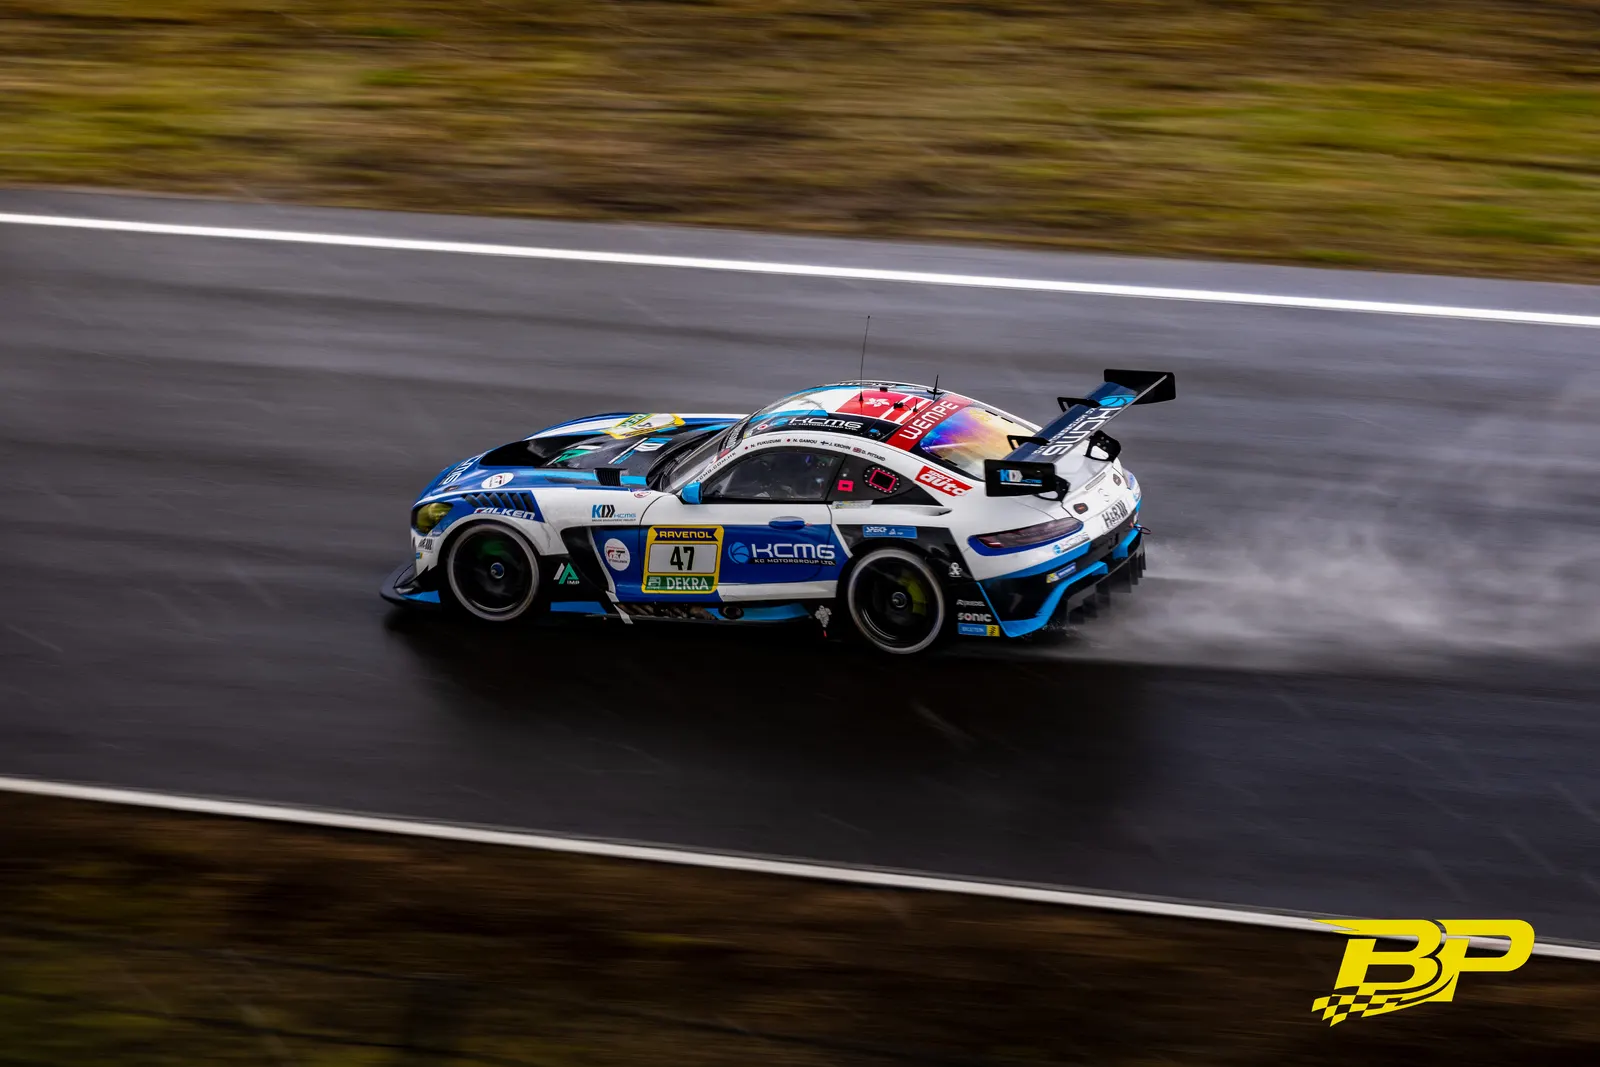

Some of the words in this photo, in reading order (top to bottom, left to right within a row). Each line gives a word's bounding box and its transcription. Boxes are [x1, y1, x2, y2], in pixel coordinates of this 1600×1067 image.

[789, 417, 864, 429] KCMG
[898, 400, 959, 440] WEMPE
[1042, 407, 1121, 456] KCMG
[919, 473, 968, 497] auto
[473, 507, 536, 520] FALKEN
[659, 530, 713, 539] RAVENOL
[670, 546, 695, 571] 47
[751, 543, 836, 560] KCMG
[666, 577, 710, 591] DEKRA
